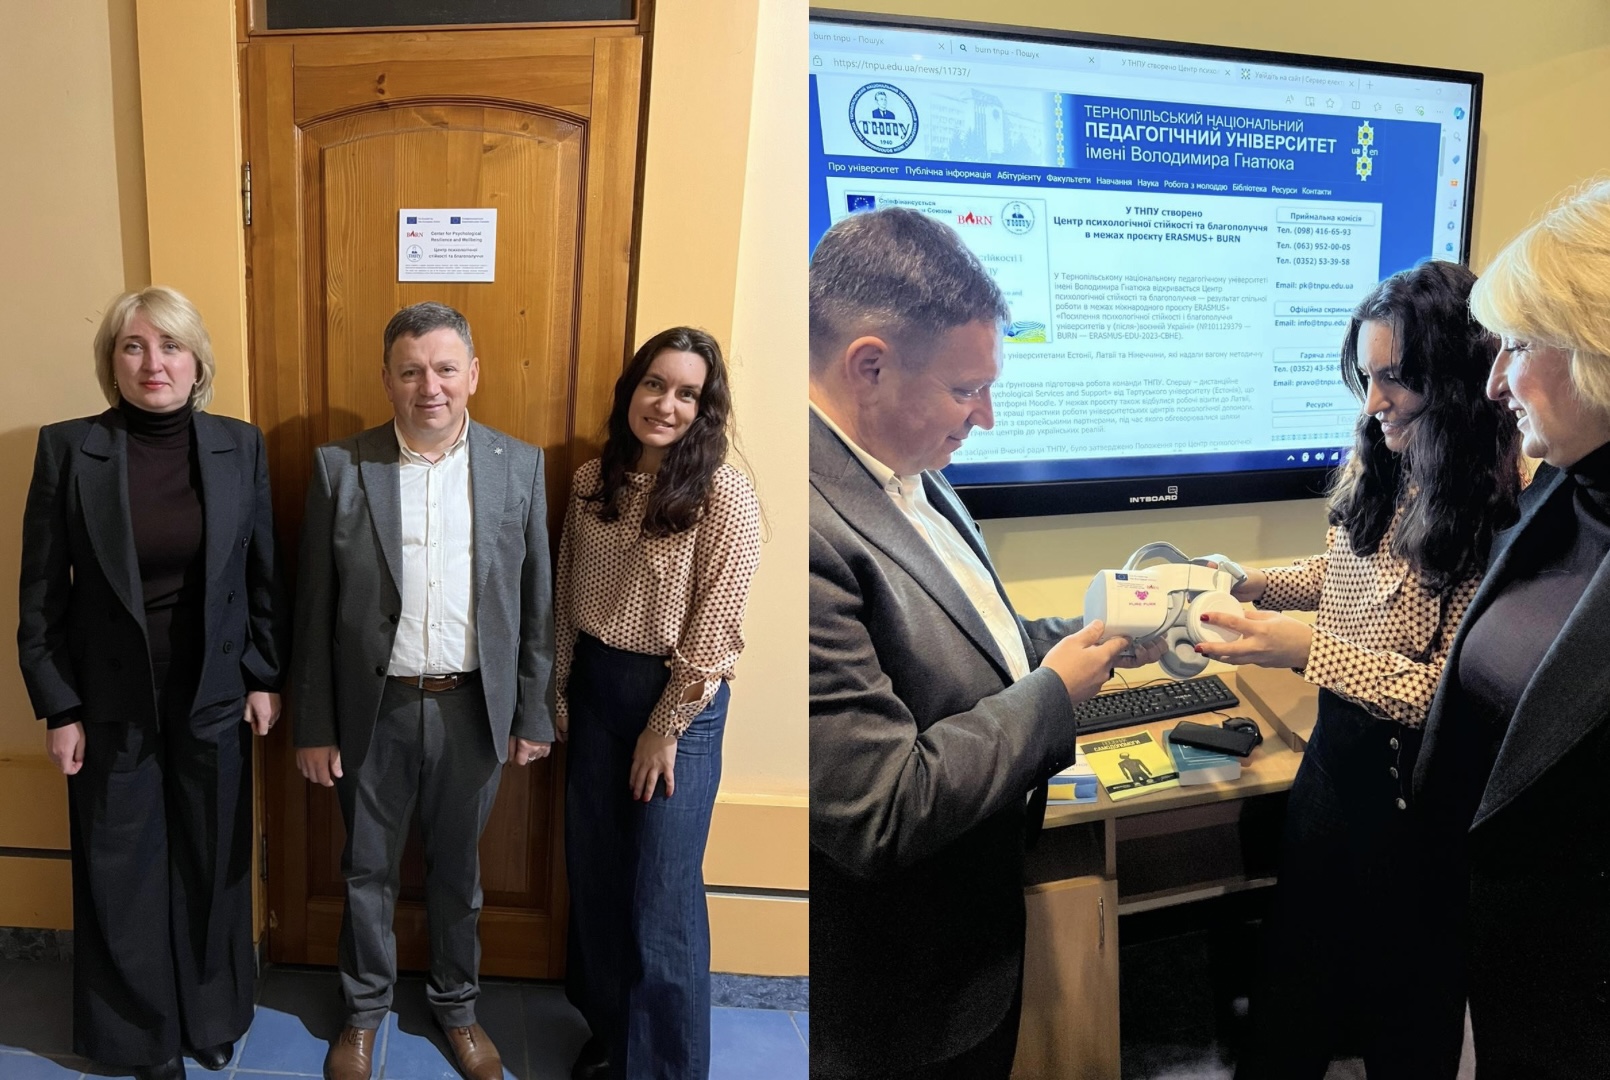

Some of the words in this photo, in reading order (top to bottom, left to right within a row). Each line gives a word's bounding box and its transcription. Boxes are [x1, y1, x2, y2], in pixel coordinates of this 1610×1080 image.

[813, 32, 831, 40] burn
[833, 34, 851, 43] tnpu
[858, 35, 884, 46] Пошук
[975, 46, 991, 54] burn
[993, 47, 1009, 56] tnpu
[1015, 49, 1039, 59] Пошук
[833, 58, 971, 77] https://tnpu.edu.ua/news/11737/
[1128, 60, 1146, 68] ТНПУ
[1147, 63, 1177, 72] створено
[1178, 64, 1198, 74] Центр
[1084, 104, 1203, 125] ТЕРНОПІЛЬСЬКИЙ
[1206, 114, 1304, 132] НАЦІОНАЛЬНИЙ
[858, 120, 910, 140] ТНПУ
[1085, 122, 1221, 147] ПЕДАГОГІЧНИЙ
[1227, 132, 1337, 153] УНІВЕРСИТЕТ
[1085, 144, 1126, 161] імені
[1131, 146, 1229, 169] Володимира
[1234, 153, 1294, 171] Гнатюка
[828, 162, 845, 172] Про
[847, 163, 899, 174] університет
[905, 166, 943, 176] Публічна
[945, 168, 992, 179] інформація
[997, 171, 1041, 182] Абітурієнту
[1046, 173, 1091, 183] Факультети
[1096, 176, 1132, 186] Навчання
[1137, 179, 1159, 188] Наука
[1164, 180, 1188, 189] Робота
[1196, 183, 1228, 191] молоддю
[1232, 183, 1267, 193] Бібліотека
[1271, 186, 1298, 195] Ресурси
[1302, 187, 1332, 196] Контакти
[927, 207, 952, 215] Союзом
[1125, 206, 1132, 215] У
[1134, 207, 1159, 216] ТНПУ
[1161, 209, 1203, 219] створено
[1290, 212, 1335, 222] Приймальна
[1337, 214, 1362, 222] комісія
[1053, 216, 1083, 227] Центр
[1085, 218, 1152, 228] психологічної
[1153, 220, 1193, 230] стійкості
[1195, 222, 1205, 230] та
[1207, 221, 1268, 233] благополуччя
[1276, 226, 1292, 234] Тел.
[1294, 226, 1313, 235] (098)
[1315, 227, 1351, 236] 416-65-93
[1085, 231, 1091, 239] в
[1093, 231, 1124, 240] межах
[1126, 232, 1163, 242] проєкту
[1165, 232, 1214, 242] ERASMUS+
[1216, 234, 1241, 243] BURN
[1276, 241, 1292, 249] Тел.
[1293, 242, 1313, 250] (063)
[1315, 242, 1351, 251] 952-00-05
[1293, 257, 1317, 266] (0352)
[1318, 258, 1350, 266] 53-39-58
[1061, 272, 1123, 282] Тернопільському
[1124, 273, 1176, 283] національному
[1178, 276, 1226, 284] педагогічному
[1228, 276, 1269, 284] університеті
[1074, 283, 1119, 292] Володимира
[1121, 284, 1151, 292] Гнатюка
[1152, 284, 1201, 293] відкривається
[1201, 285, 1223, 293] Центр
[1275, 281, 1297, 289] Email:
[1298, 282, 1354, 290] pk@tnpu.edu.ua
[1055, 293, 1105, 301] психологічної
[1106, 293, 1138, 301] стійкості
[1148, 294, 1197, 302] благополуччя
[1206, 295, 1240, 303] результат
[1241, 295, 1268, 303] спільної
[1055, 302, 1082, 311] роботи
[1115, 303, 1164, 312] міжнародного
[1290, 305, 1323, 314] Офіційна
[1056, 312, 1100, 320] «Посилення
[1102, 312, 1150, 321] психологічної
[1186, 313, 1233, 321] благополуччя
[1056, 323, 1105, 331] університетів
[1167, 323, 1195, 331] Україні»
[1274, 319, 1296, 327] Email:
[1089, 332, 1184, 340] ERASMUS-EDU-2023-CBHE).
[1007, 352, 1065, 360] університетами
[1067, 351, 1094, 360] Естонії,
[1096, 351, 1117, 359] Латвії
[1127, 351, 1166, 359] Німеччини,
[1290, 365, 1313, 373] (0352)
[1005, 381, 1044, 389] ґрунтовна
[1045, 380, 1084, 389] підготовча
[1085, 379, 1111, 388] робота
[1112, 379, 1142, 387] команди
[1165, 378, 1192, 387] Спершу
[1199, 377, 1239, 386] дистанційне
[1273, 379, 1295, 387] Email:
[1126, 388, 1167, 396] Тартуського
[1168, 387, 1211, 396] університету
[1028, 399, 1057, 407] Moodle.
[1141, 397, 1175, 405] відбулися
[1026, 409, 1061, 417] практики
[1062, 407, 1088, 416] роботи
[1088, 407, 1149, 416] університетських
[1149, 406, 1175, 414] центрів
[1176, 404, 1221, 413] психологічної
[1016, 418, 1072, 427] європейськими
[1073, 417, 1118, 425] партнерами,
[996, 429, 1025, 437] центрів
[1037, 427, 1079, 436] українських
[1129, 494, 1178, 503] INTBOARD
